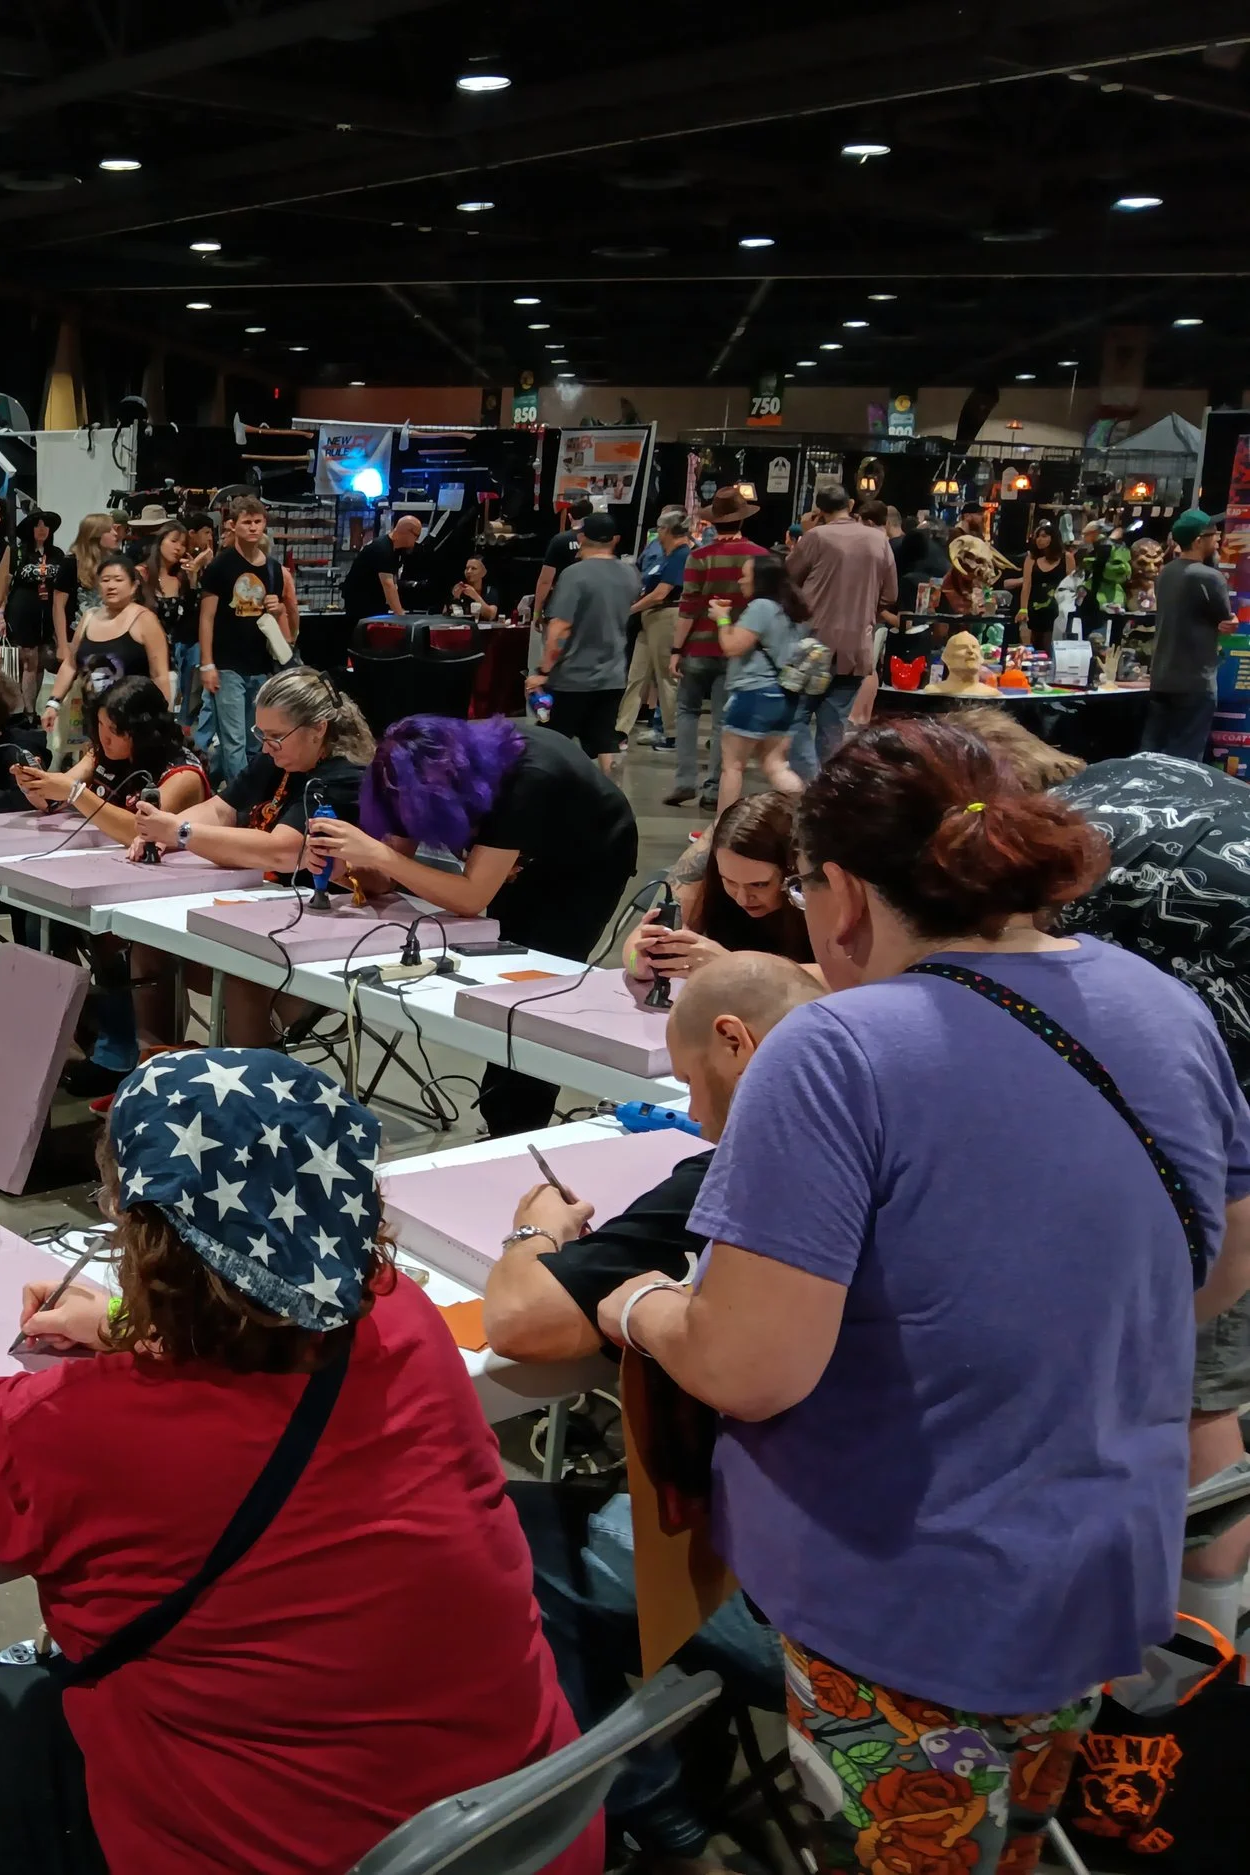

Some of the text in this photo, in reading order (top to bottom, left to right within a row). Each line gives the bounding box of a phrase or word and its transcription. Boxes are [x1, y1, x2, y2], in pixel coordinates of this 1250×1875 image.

[751, 397, 781, 415] 750
[514, 406, 537, 423] 850
[327, 435, 352, 446] NEW
[325, 446, 351, 457] RULE
